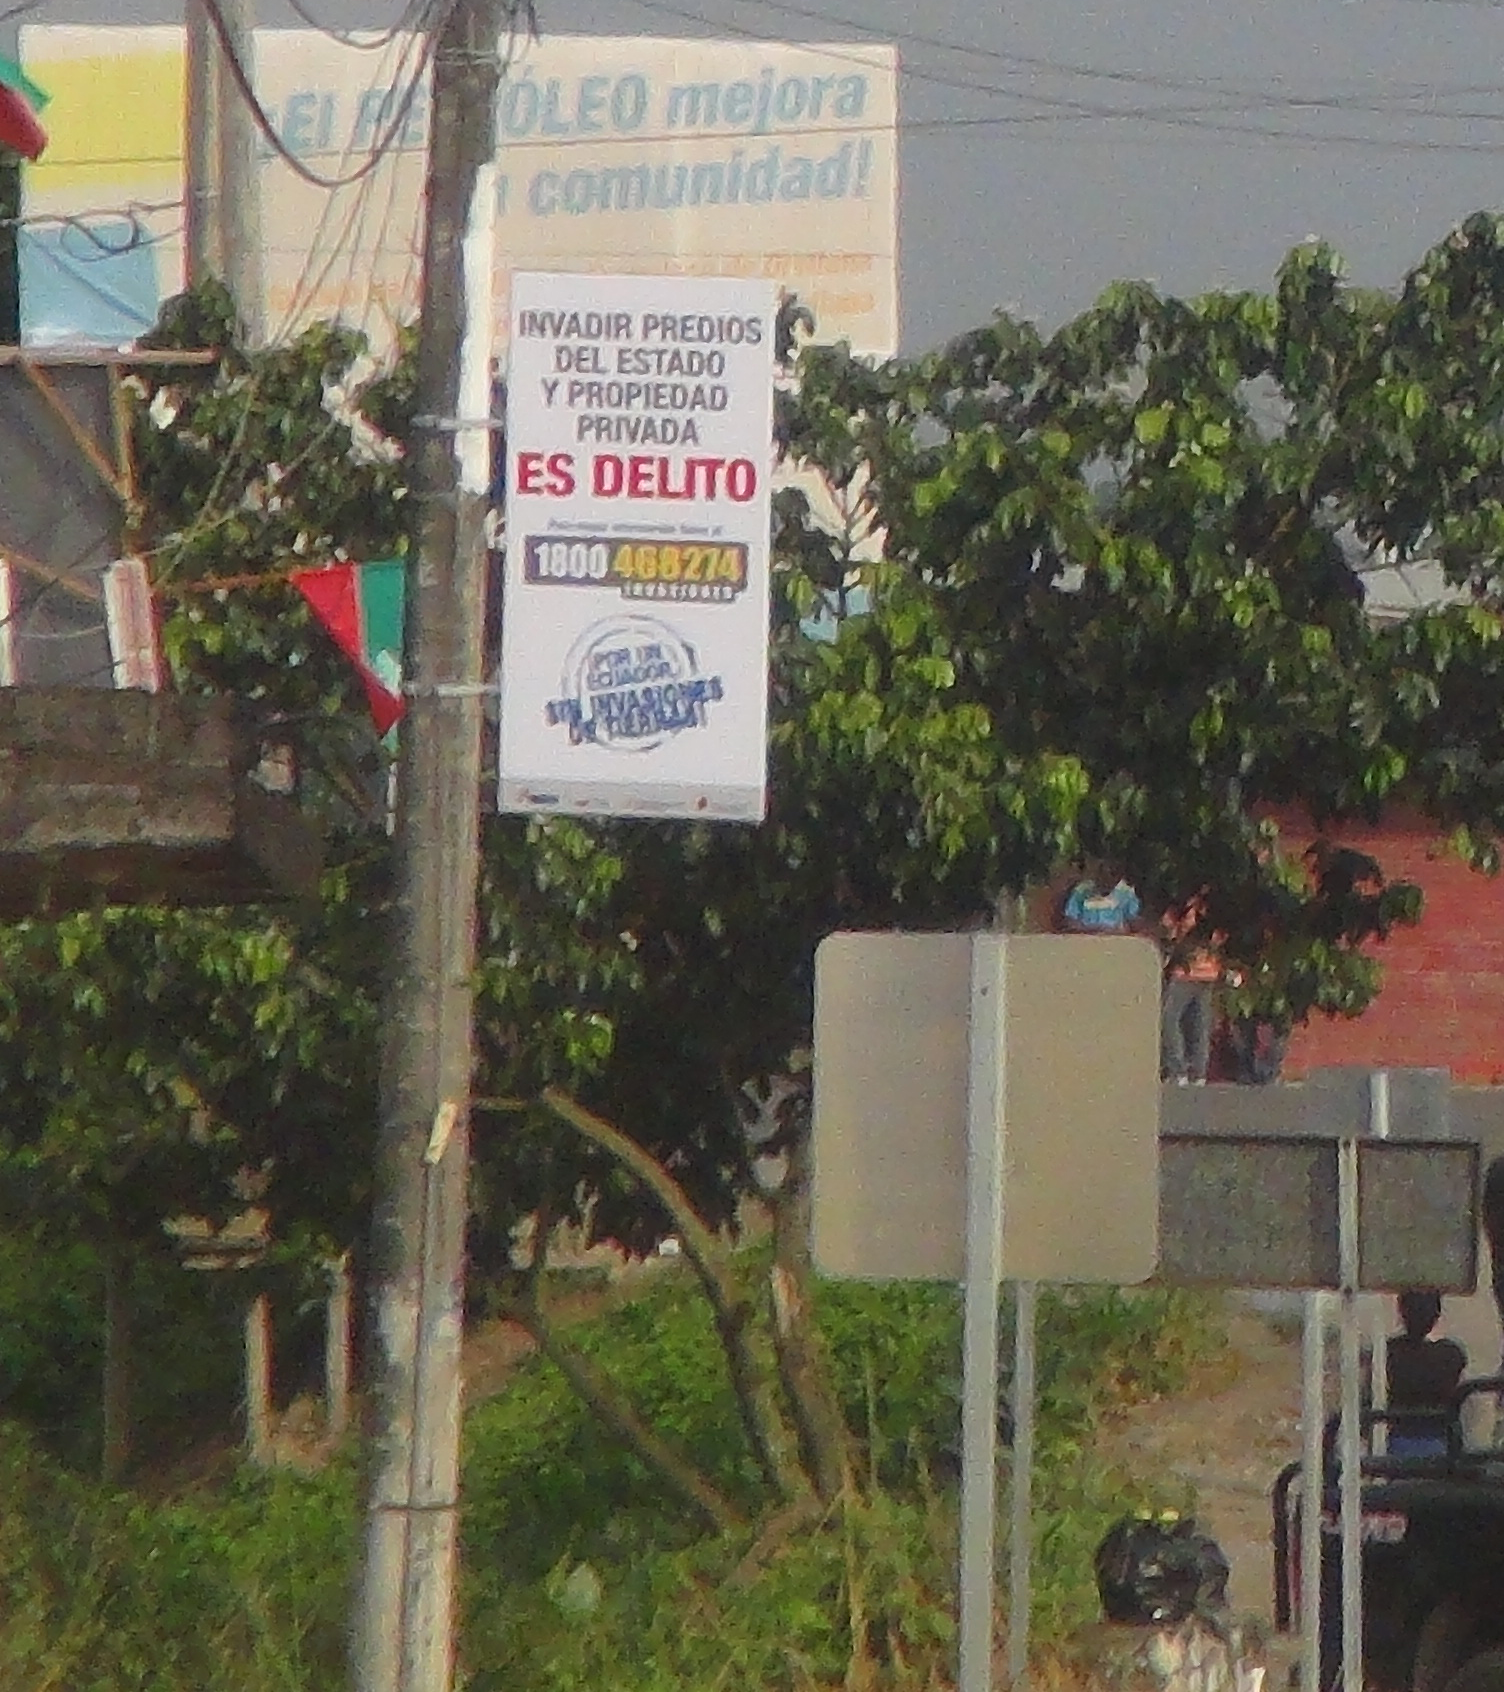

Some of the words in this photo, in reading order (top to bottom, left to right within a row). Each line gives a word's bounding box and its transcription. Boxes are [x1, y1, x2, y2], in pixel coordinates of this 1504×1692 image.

[356, 69, 647, 146] PEÓLEO
[667, 67, 869, 137] mejora
[528, 138, 874, 217] comunidad!
[518, 311, 634, 343] INVADIR
[642, 313, 763, 346] PREDIOS
[556, 344, 608, 375] DEL
[617, 348, 726, 379] ESTADO
[541, 378, 560, 406] Y
[567, 380, 728, 413] PROPIEDAD
[577, 414, 701, 446] PRIVADA
[516, 451, 576, 498] ES
[592, 453, 757, 504] DELITO
[533, 541, 609, 579] 1800
[612, 544, 742, 583] 468274
